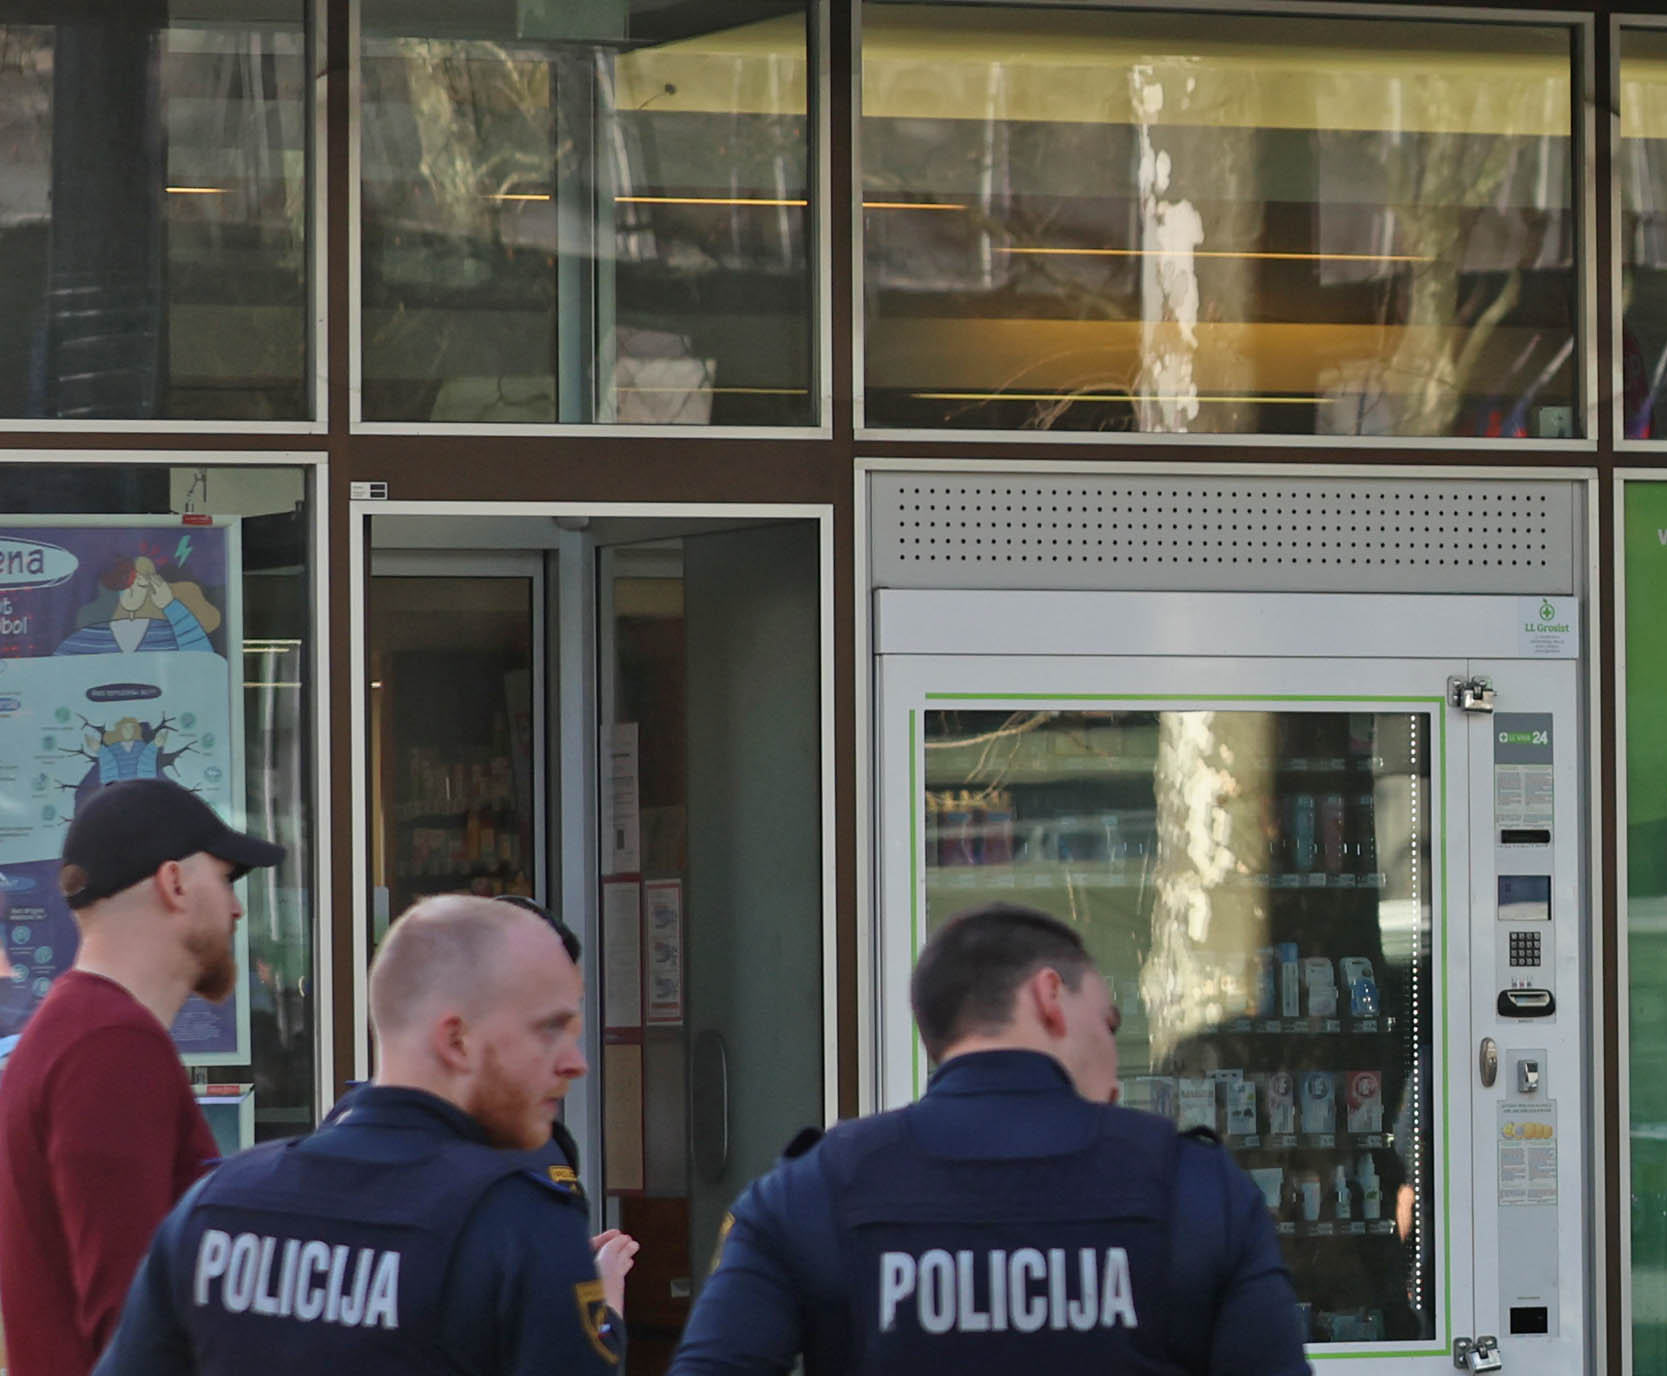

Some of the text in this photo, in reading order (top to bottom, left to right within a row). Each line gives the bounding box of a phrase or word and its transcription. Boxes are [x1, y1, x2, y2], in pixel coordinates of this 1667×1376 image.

[1532, 730, 1548, 744] 24
[194, 1229, 400, 1330] POLICIJA
[880, 1247, 1138, 1334] POLICIJA
